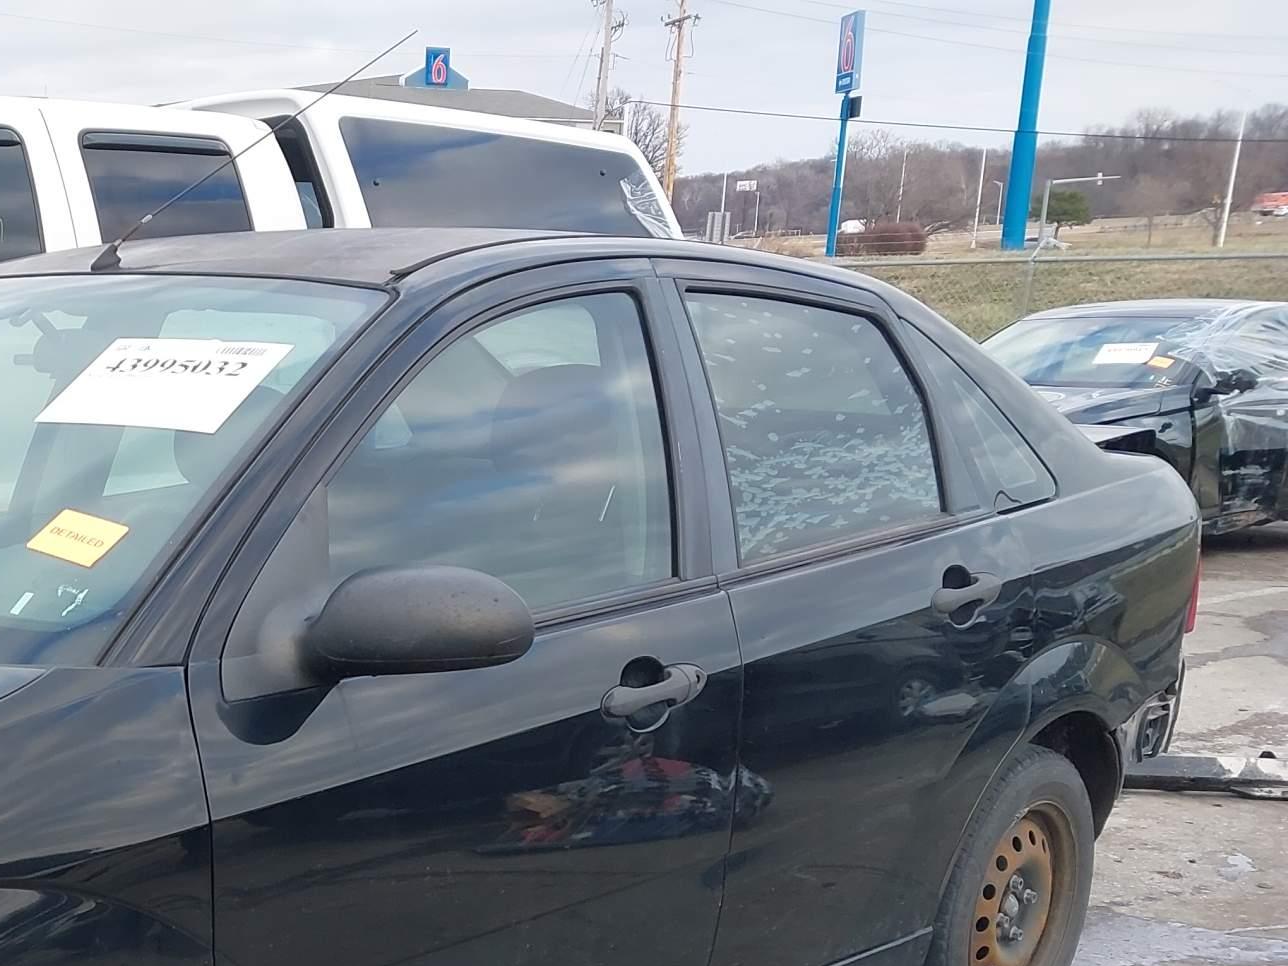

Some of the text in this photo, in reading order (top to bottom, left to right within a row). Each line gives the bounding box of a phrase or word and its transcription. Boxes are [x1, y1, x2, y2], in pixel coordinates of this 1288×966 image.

[431, 53, 447, 84] 6
[105, 357, 249, 377] 43995032
[49, 526, 105, 548] DETAILED
